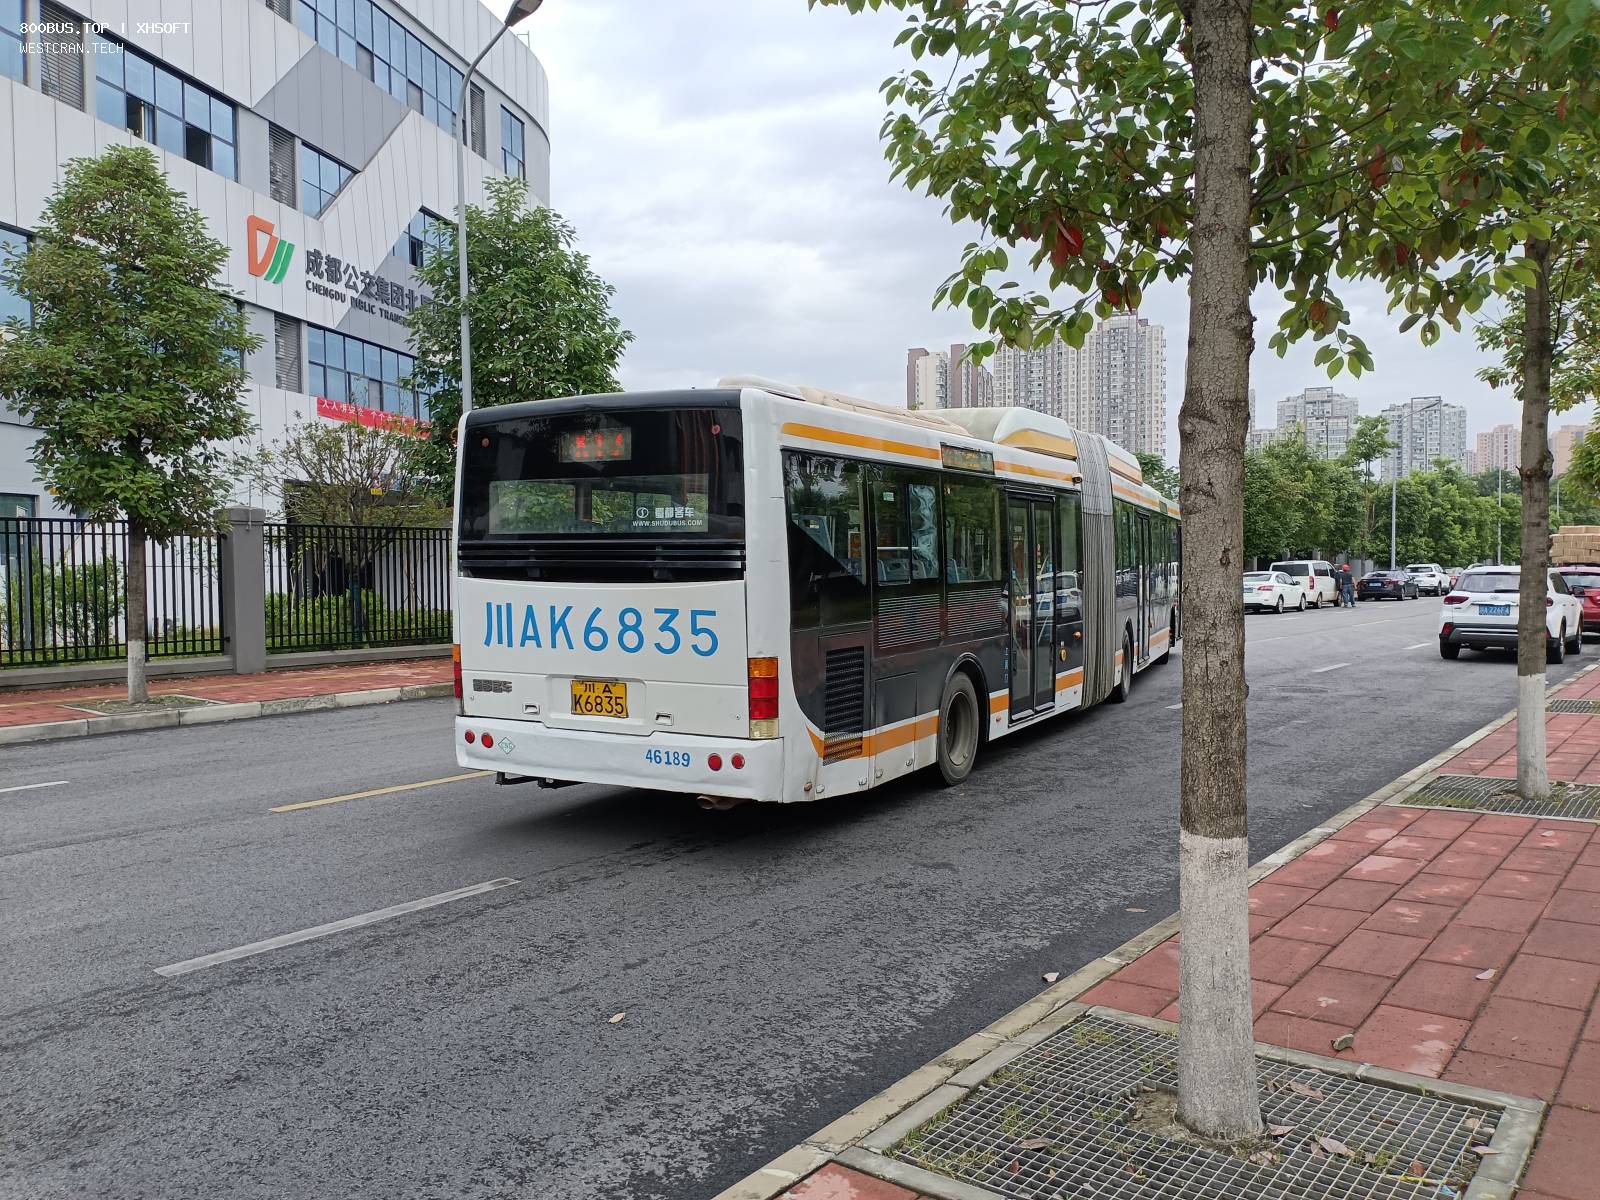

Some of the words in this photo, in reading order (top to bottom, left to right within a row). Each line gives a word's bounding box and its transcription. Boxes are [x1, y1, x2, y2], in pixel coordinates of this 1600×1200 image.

[305, 279, 346, 303] CHENGDU
[632, 519, 703, 527] WWW.SHUDUBUS.COM
[483, 601, 719, 657] 川AK6835
[573, 693, 624, 715] K6835
[645, 749, 691, 767] 46189
